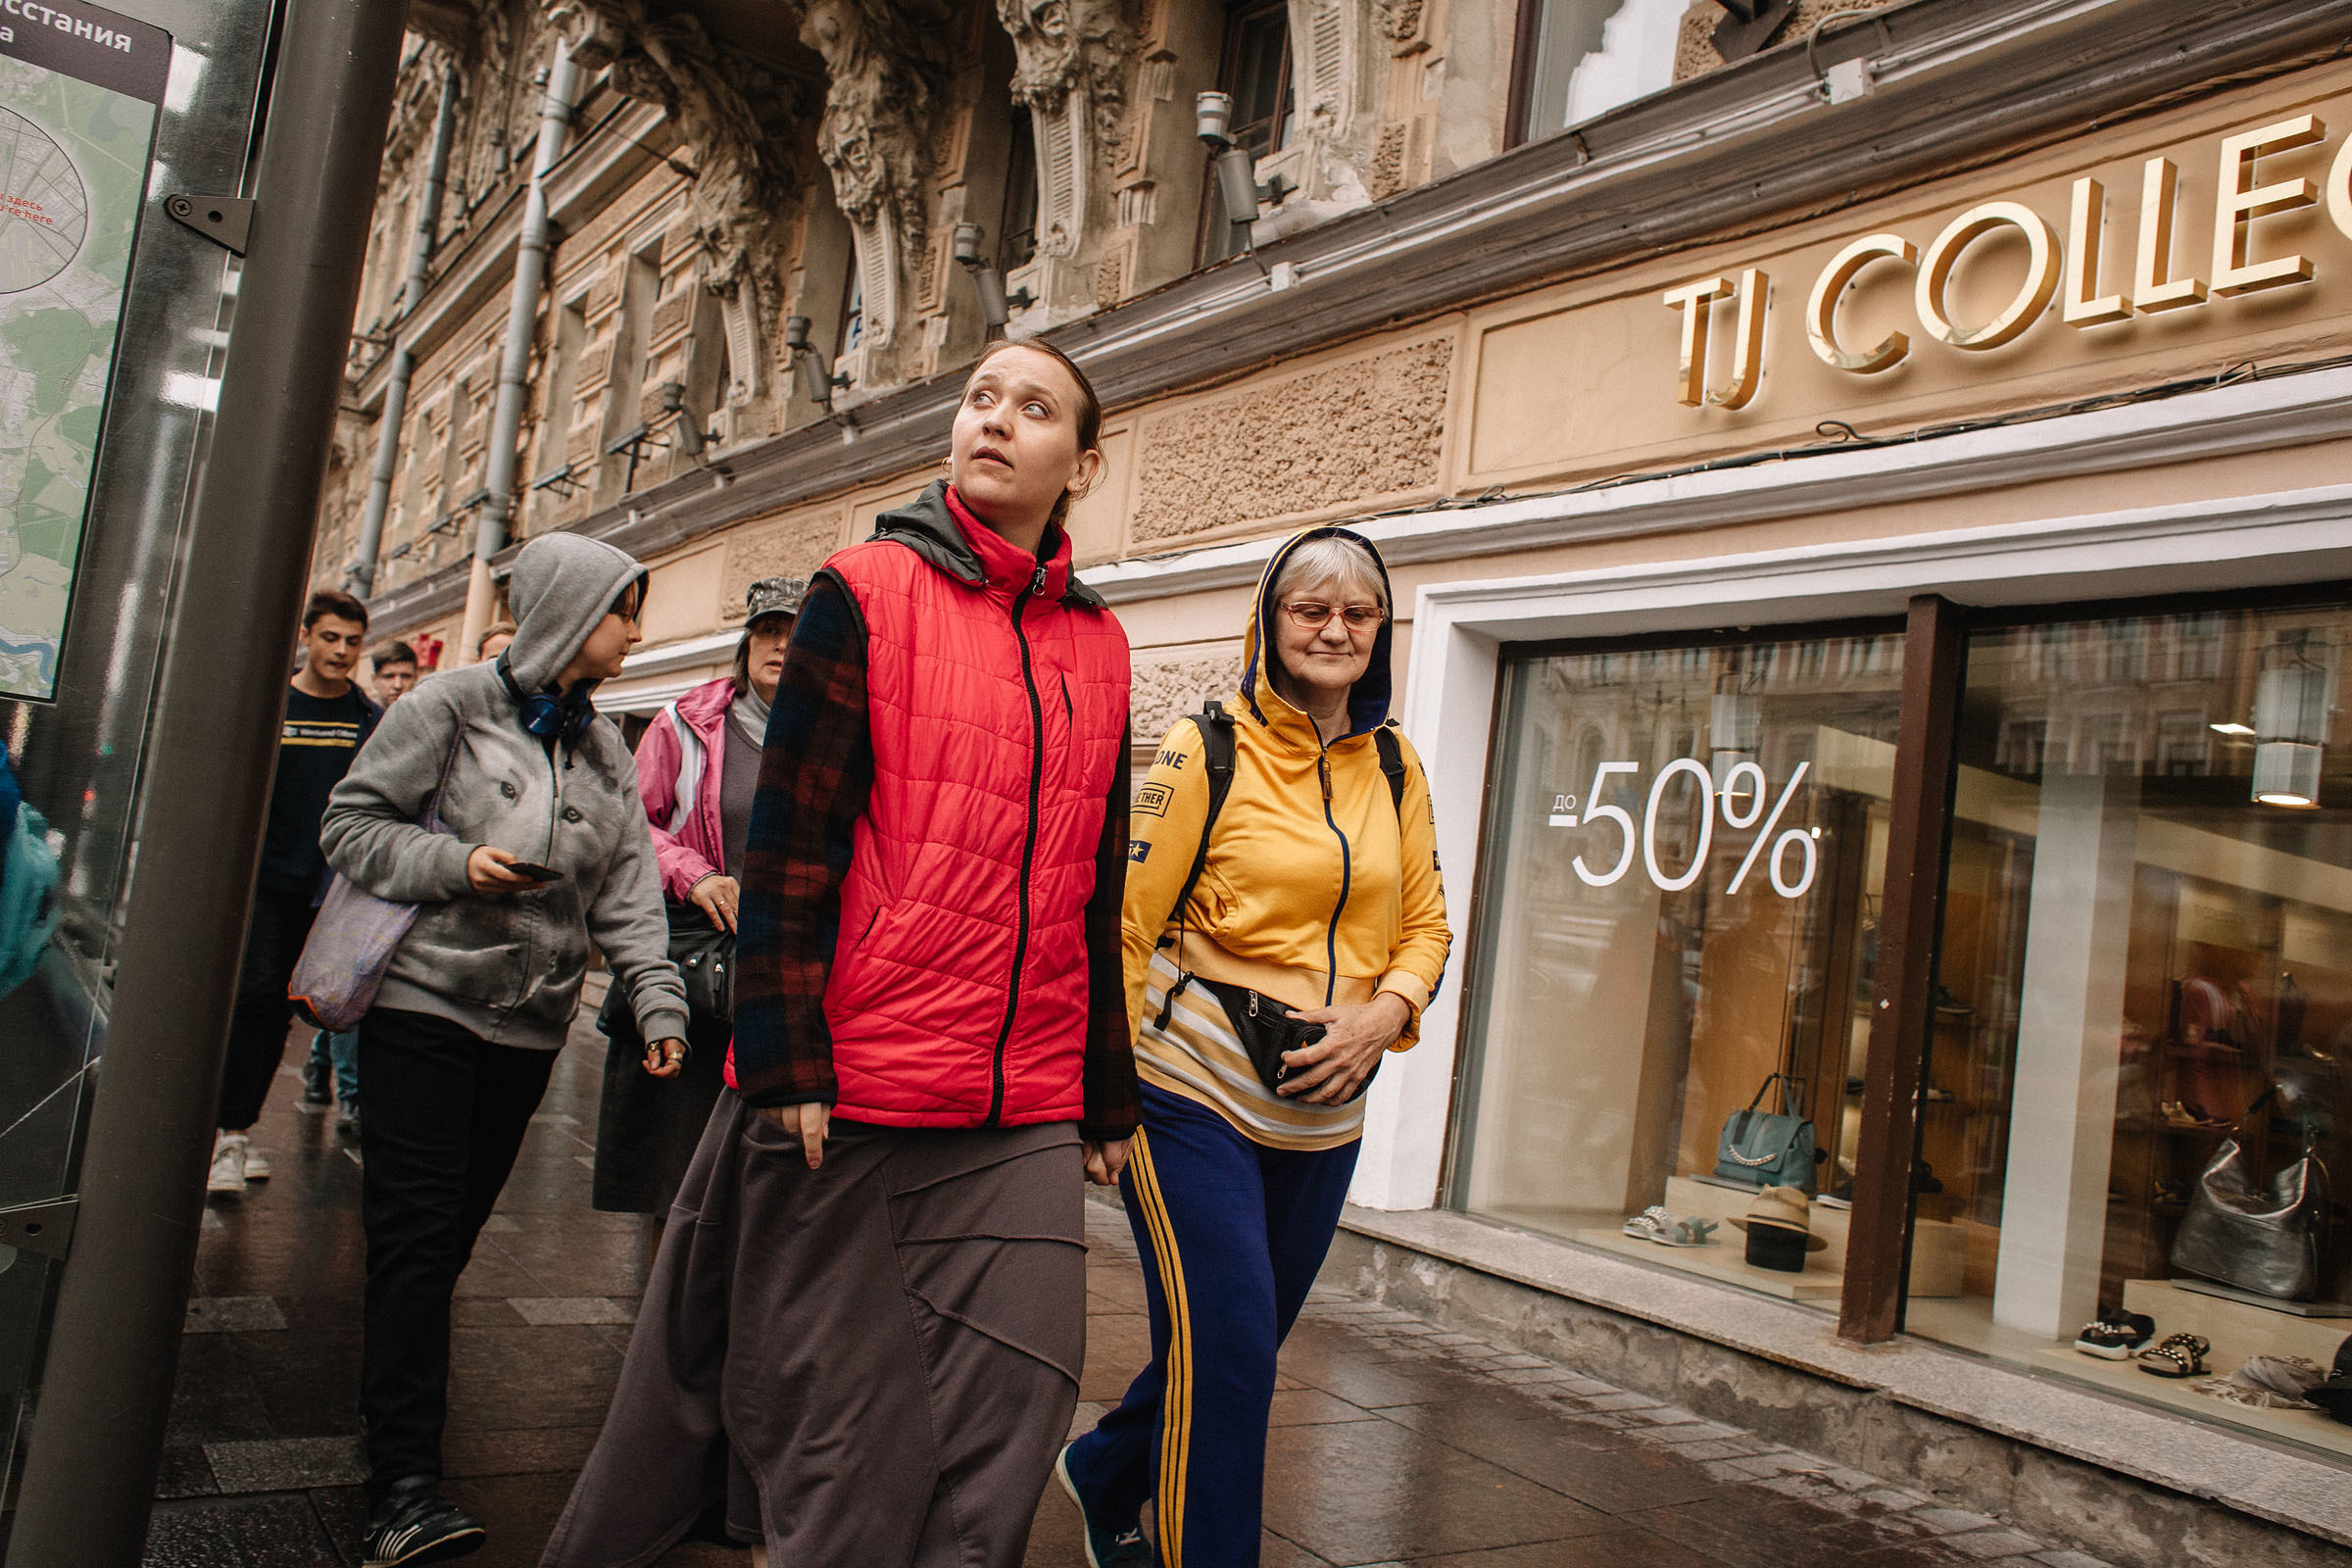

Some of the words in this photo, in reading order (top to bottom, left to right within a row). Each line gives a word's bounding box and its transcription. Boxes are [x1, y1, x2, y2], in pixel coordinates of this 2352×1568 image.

[0, 0, 132, 53] сстания
[7, 195, 43, 212] здесь
[24, 210, 53, 225] here
[1663, 268, 1769, 411] TJ
[1805, 113, 2352, 375] COLLE
